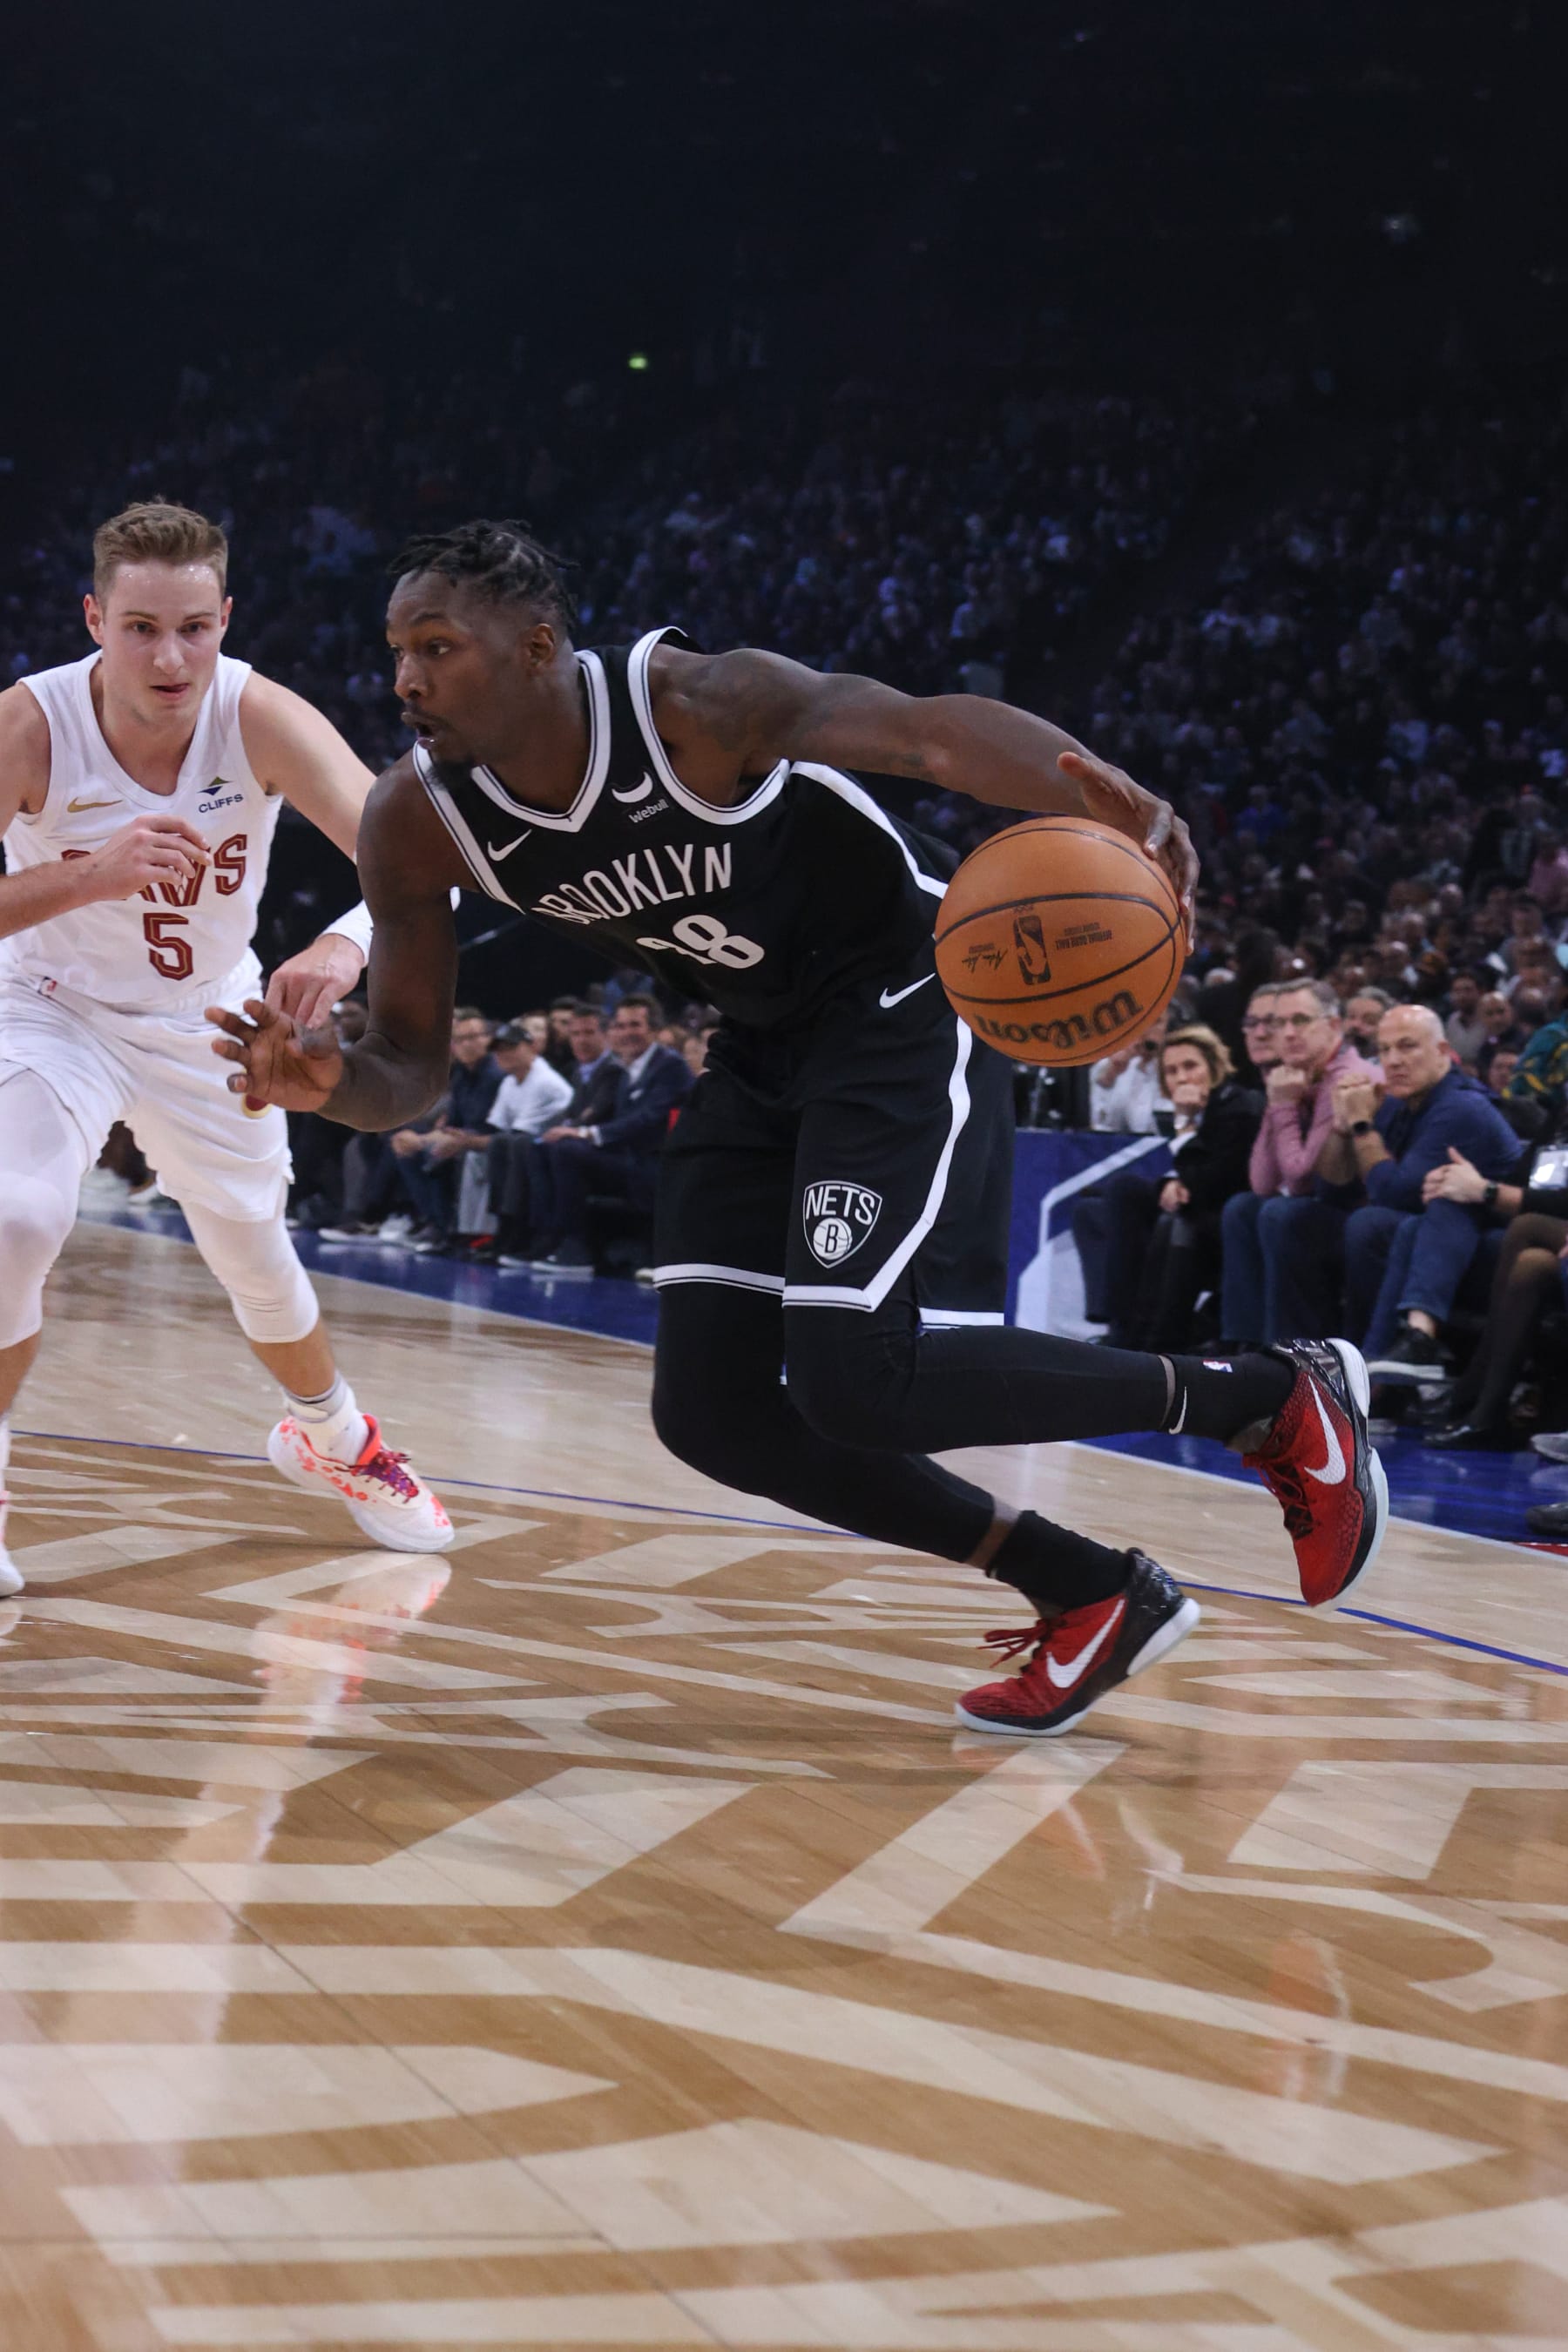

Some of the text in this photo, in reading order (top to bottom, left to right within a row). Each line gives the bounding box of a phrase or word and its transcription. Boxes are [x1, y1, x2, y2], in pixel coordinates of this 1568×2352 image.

[198, 793, 244, 814] CLIFFS
[531, 842, 732, 925] BROOKLYN
[143, 912, 194, 982] 5
[972, 989, 1144, 1050] Wilson
[805, 1185, 875, 1226] NETS
[823, 1223, 840, 1254] B
